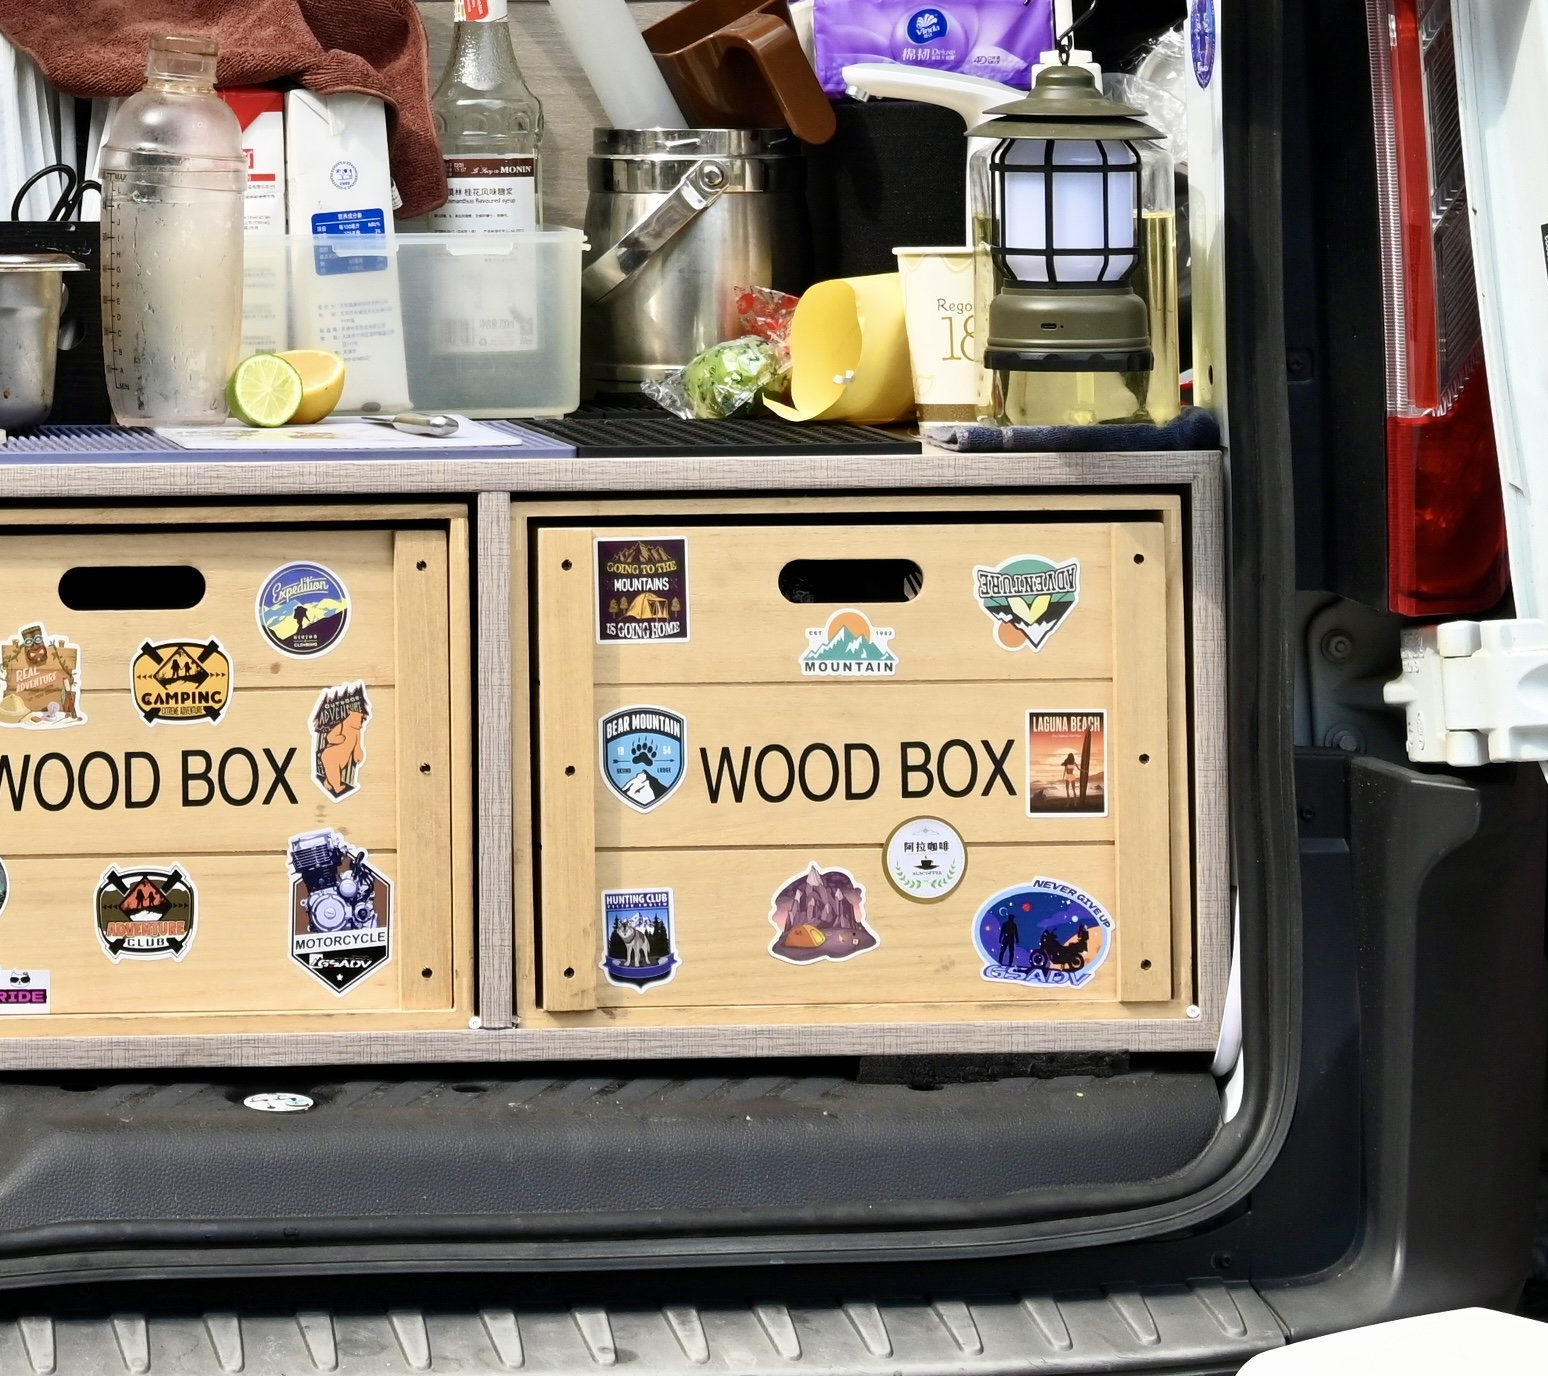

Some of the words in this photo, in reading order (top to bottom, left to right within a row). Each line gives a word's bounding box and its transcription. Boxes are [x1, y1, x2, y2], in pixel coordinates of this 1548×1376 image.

[500, 165, 532, 175] MONIN
[607, 561, 639, 575] GOING
[642, 562, 655, 575] TO
[658, 560, 678, 573] THE
[614, 578, 669, 591] MOUNTAINS
[978, 565, 1077, 597] ADVENTURE
[273, 577, 330, 604] Expedition
[606, 623, 616, 635] IS
[618, 623, 650, 639] GOING
[651, 621, 680, 638] HOME
[16, 667, 40, 683] REAL
[805, 661, 893, 673] MOUNTAIN
[15, 670, 58, 694] ADVENTURE
[606, 717, 630, 738] BEAR
[631, 714, 681, 738] MOUNTAIN
[1033, 716, 1069, 733] LAGUNA
[1070, 716, 1101, 733] BEACH
[181, 747, 299, 808] BOX
[699, 742, 880, 804] WOOD
[899, 739, 1017, 799] BOX
[904, 841, 950, 853] 阿拉咖啡
[606, 894, 645, 906] HUNTING
[645, 893, 669, 904] CLUB
[1033, 880, 1078, 897] NEVER
[1077, 893, 1102, 916] GIVE
[1098, 914, 1111, 929] UP
[106, 920, 186, 938] ADVENTURE
[127, 938, 165, 947] CLUB
[295, 932, 386, 950] MOTORCYCLE
[984, 965, 1092, 986] GSADV
